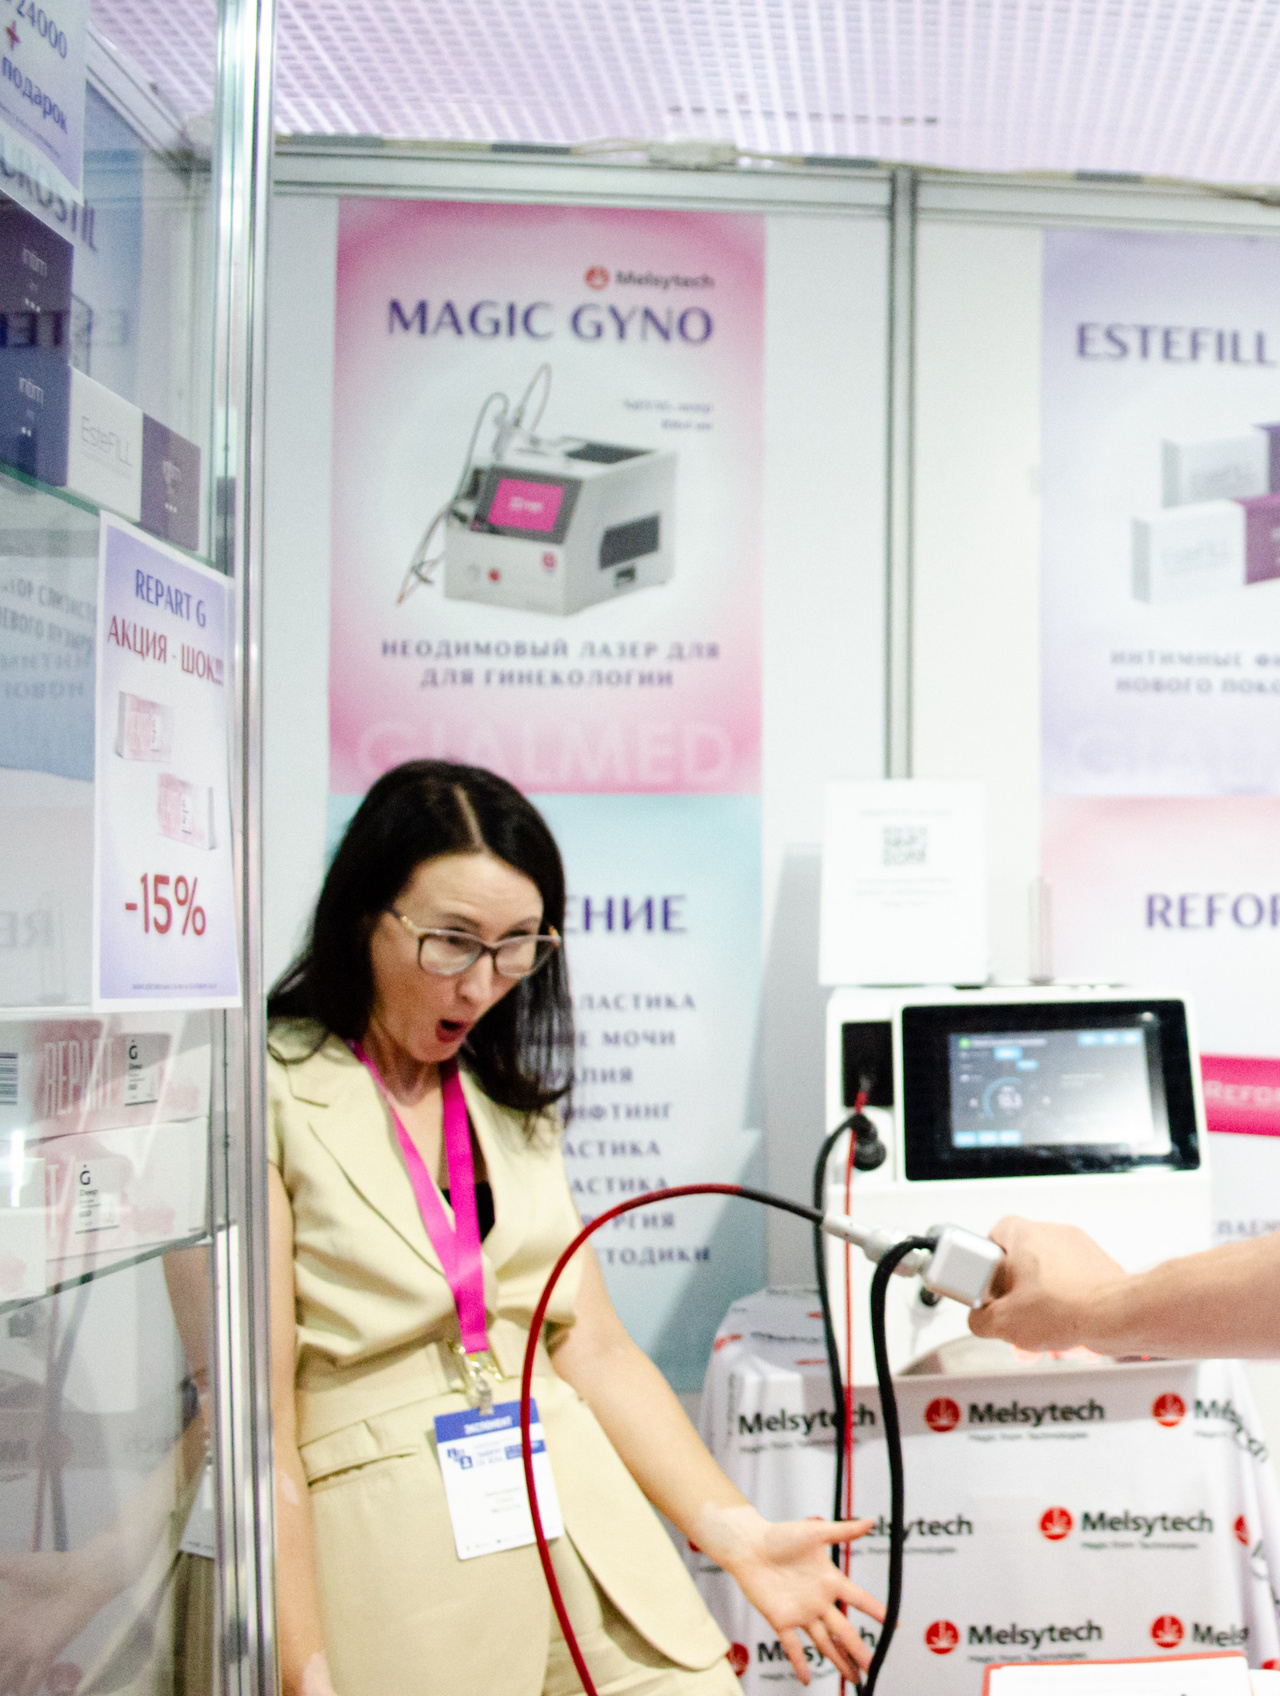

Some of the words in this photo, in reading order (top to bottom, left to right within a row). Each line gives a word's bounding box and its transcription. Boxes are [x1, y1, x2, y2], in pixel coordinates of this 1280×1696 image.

[2, 56, 67, 135] подарок
[615, 268, 714, 291] Melsytech
[387, 299, 554, 341] MAGIC
[570, 302, 714, 345] GYNO
[1076, 322, 1275, 367] ESTEFILL
[135, 568, 192, 622] REPART
[196, 599, 206, 628] G
[107, 615, 167, 664] АКЦИЯ
[381, 636, 570, 660] НЕОДИМОВЫЙ
[580, 639, 659, 660] ЛАЗЕР
[666, 641, 720, 662] ДЛЯ
[1110, 648, 1243, 669] ИНТИМНЫЕ
[420, 668, 475, 689] ДЛЯ
[483, 668, 674, 689] ГИНЕКОЛОГИИ
[1115, 675, 1213, 695] НОВОГО
[125, 872, 206, 936] -15%
[580, 993, 696, 1012] ЛАСТИКА
[602, 1029, 676, 1048] МОЧИ
[738, 1403, 877, 1436] Melsytch
[968, 1399, 1105, 1428] Melsytech
[1081, 1508, 1213, 1538] Melsytech
[968, 1620, 1103, 1650] Melsytech
